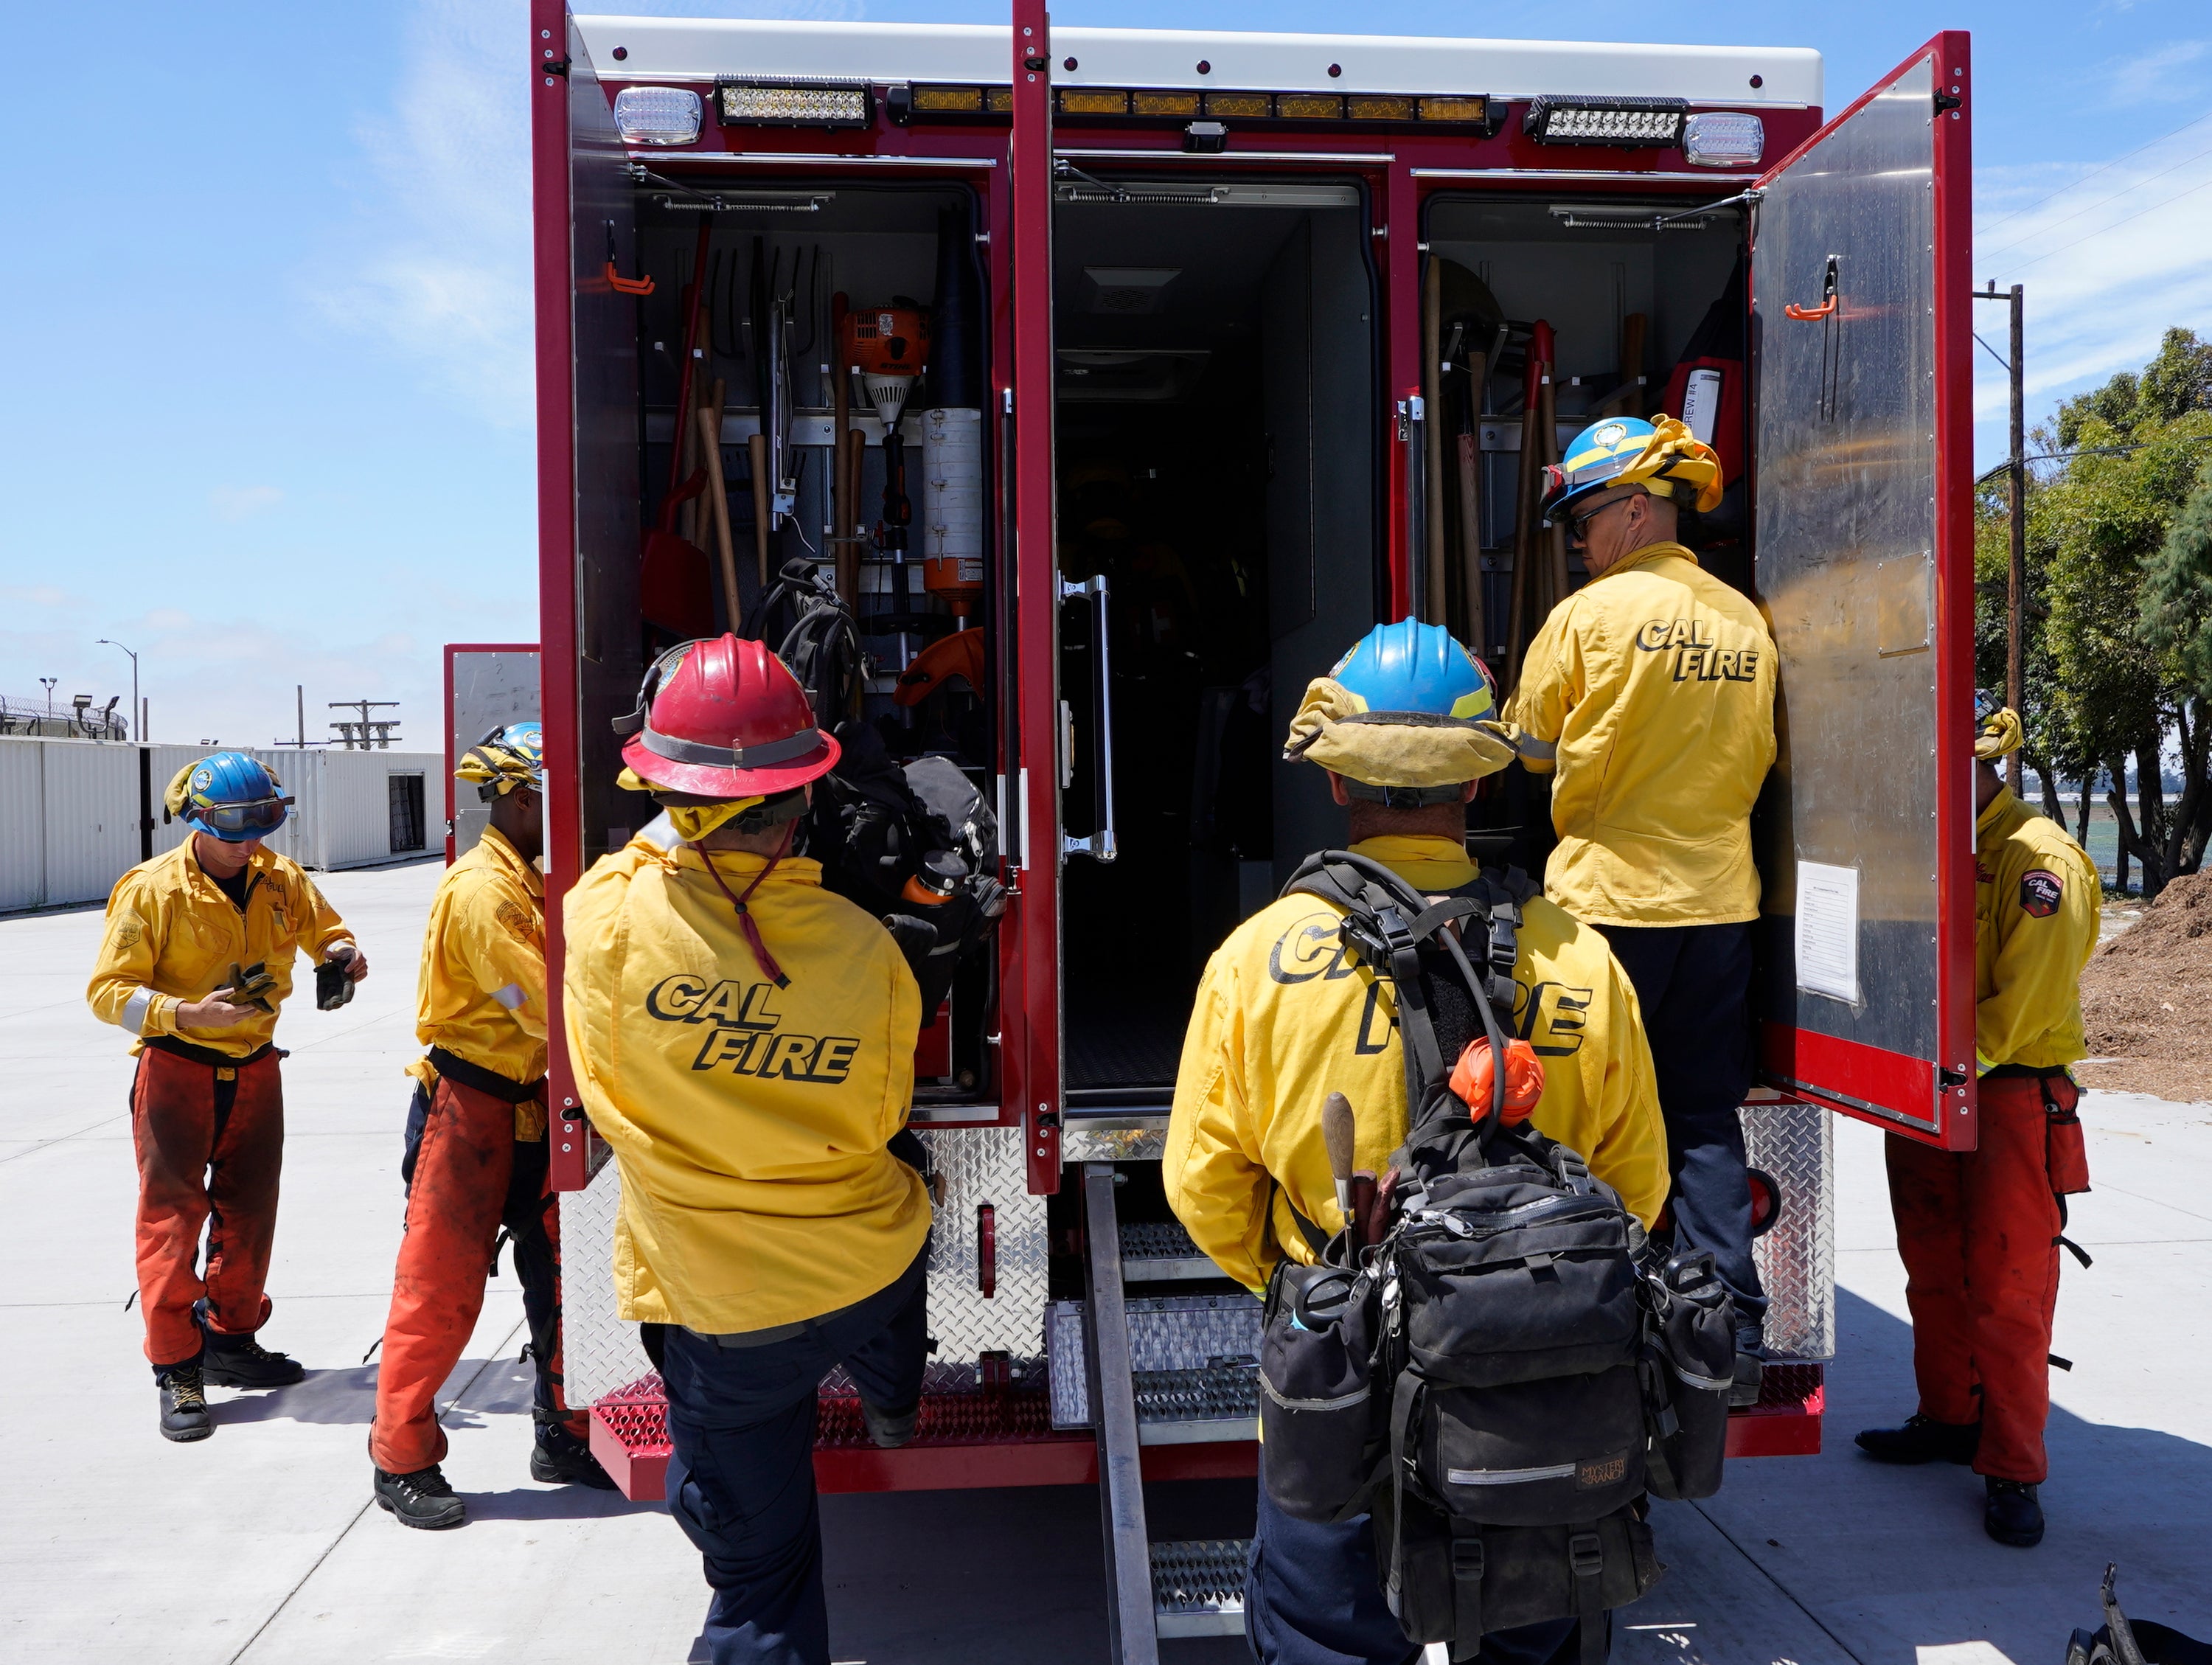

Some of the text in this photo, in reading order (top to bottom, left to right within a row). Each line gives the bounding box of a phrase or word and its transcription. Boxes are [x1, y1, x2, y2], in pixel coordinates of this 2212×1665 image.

[1635, 619, 1714, 652] CAL
[1673, 650, 1759, 682] FIRE
[2028, 879, 2048, 889] CAL
[2036, 886, 2059, 899] FIRE
[646, 974, 782, 1030] CAL
[1355, 981, 1593, 1056] FE
[692, 1030, 860, 1084] FIRE
[1582, 1457, 1624, 1476] MYSTERY
[1590, 1467, 1624, 1484] RANCH
